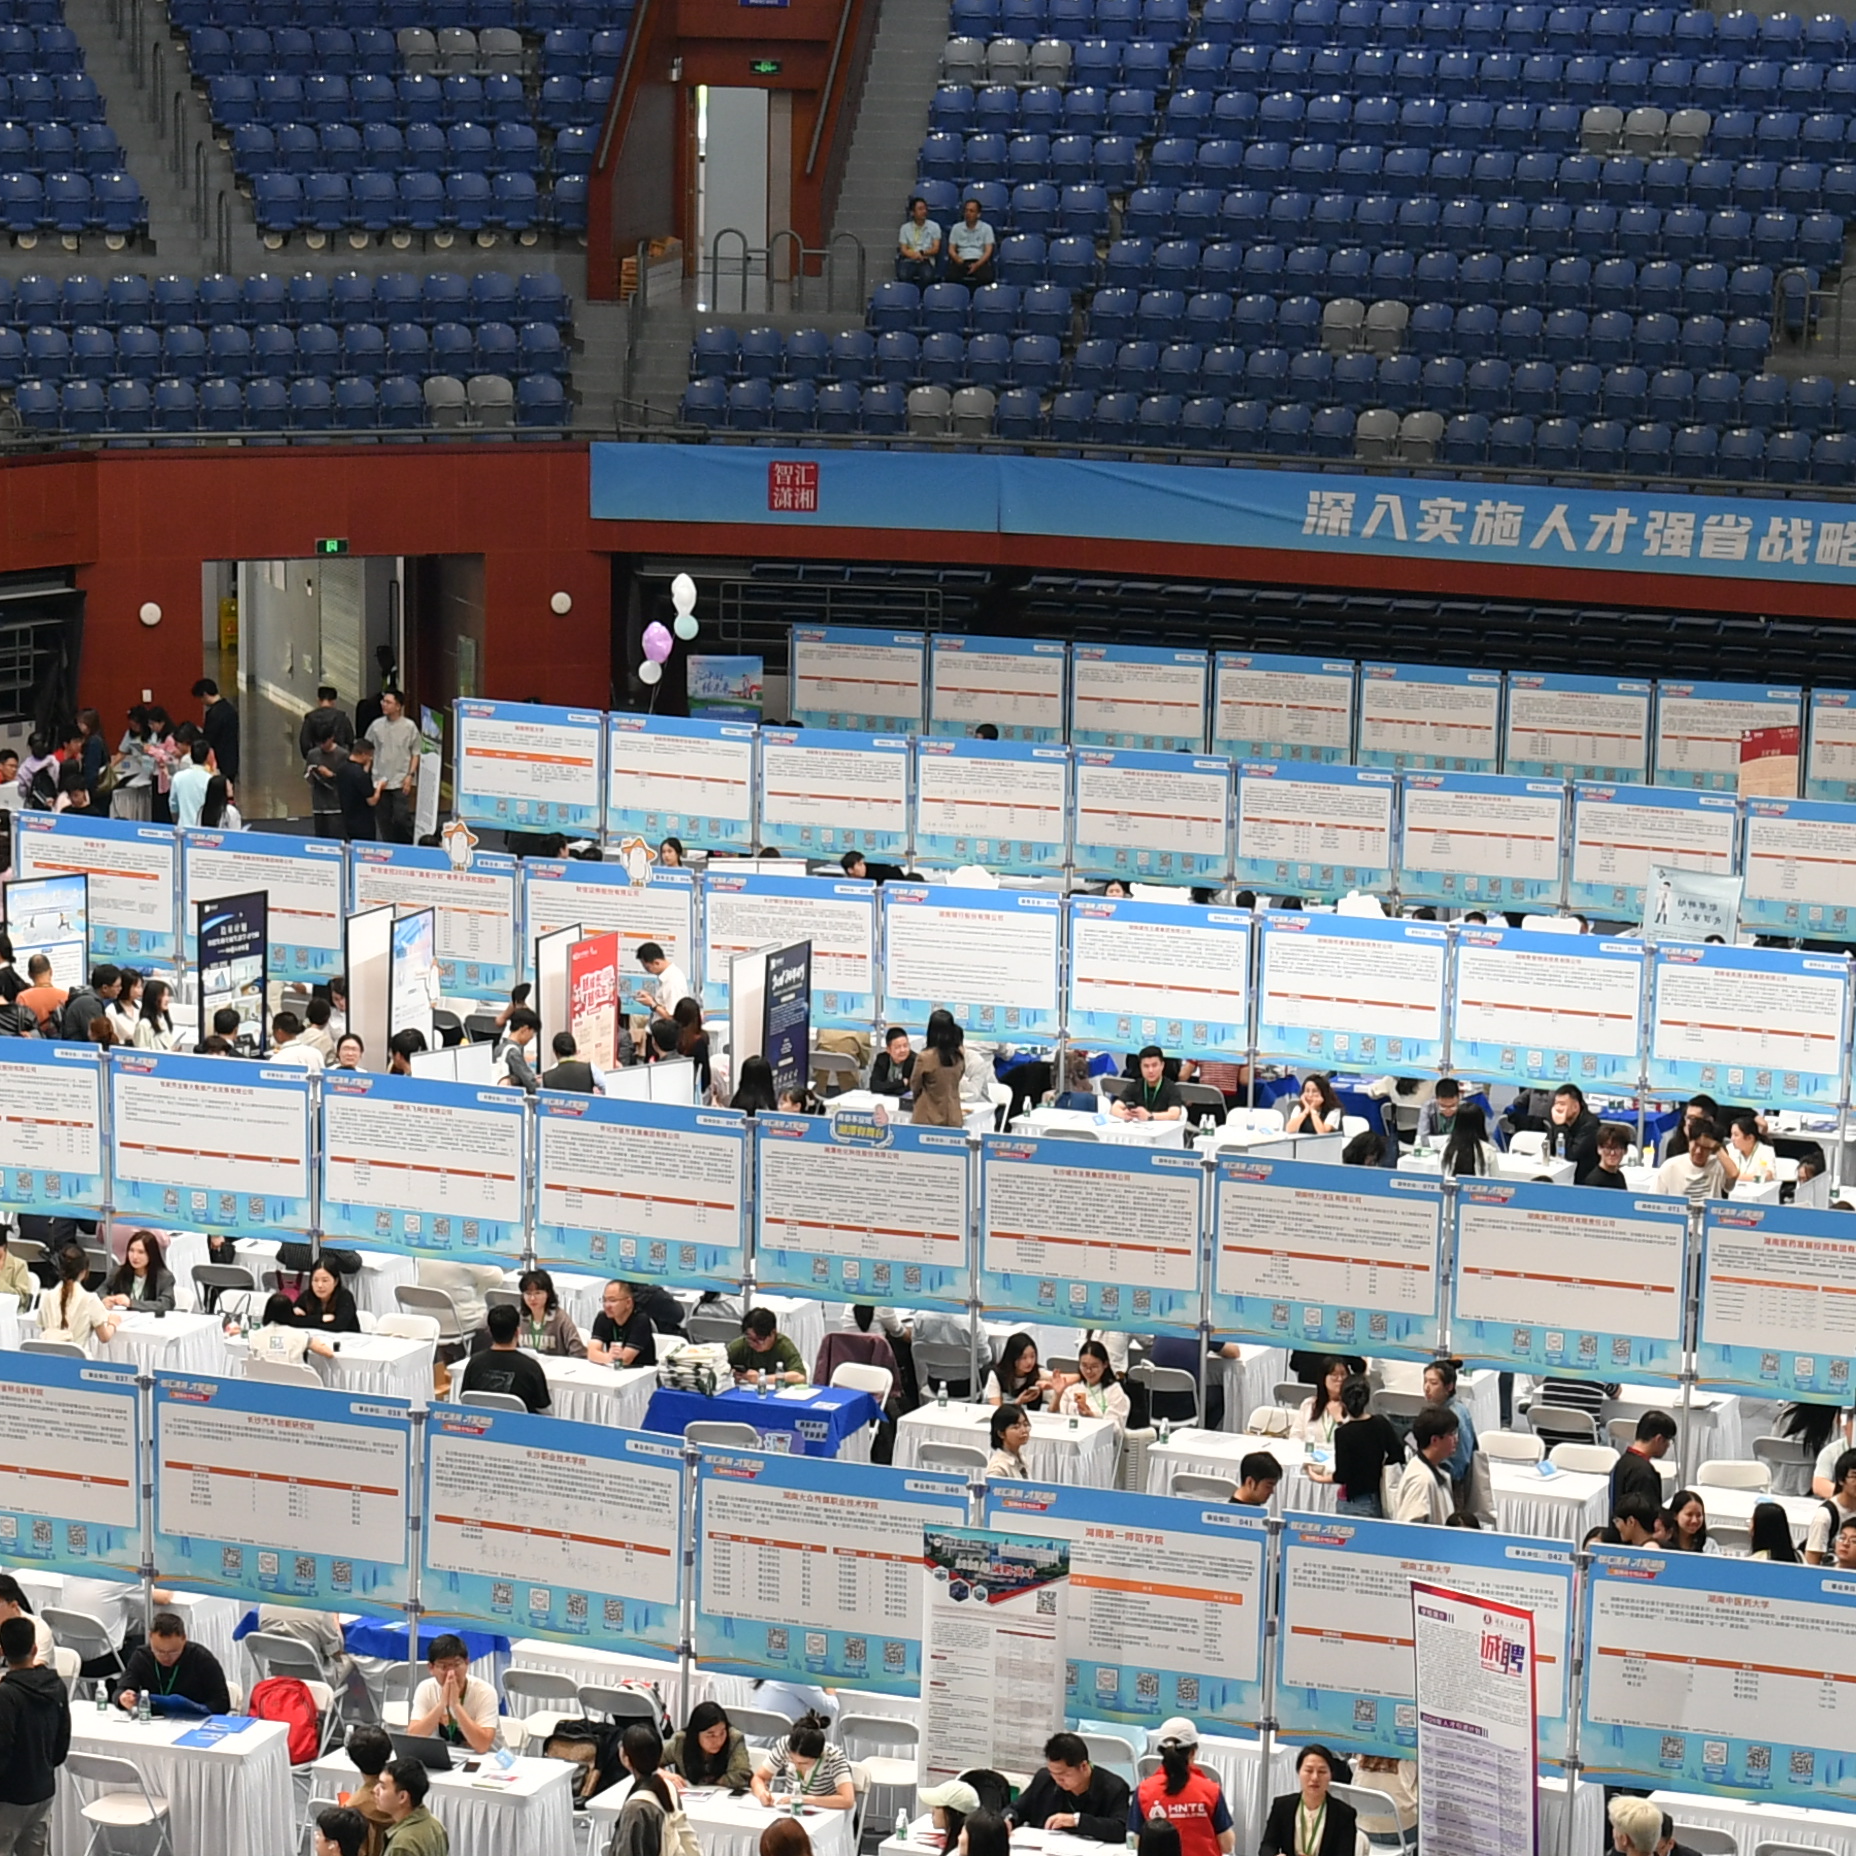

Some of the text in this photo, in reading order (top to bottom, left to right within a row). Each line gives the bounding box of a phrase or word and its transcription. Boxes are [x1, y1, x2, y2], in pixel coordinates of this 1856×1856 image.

[774, 463, 817, 486] 智汇
[774, 486, 817, 510] 潇湘
[1085, 1528, 1164, 1545] 湖南第一师范学院
[1400, 1561, 1451, 1574] 湖南工商大学
[1707, 1594, 1770, 1609] 湖南中医药大学
[1480, 1629, 1526, 1675] 诚聘
